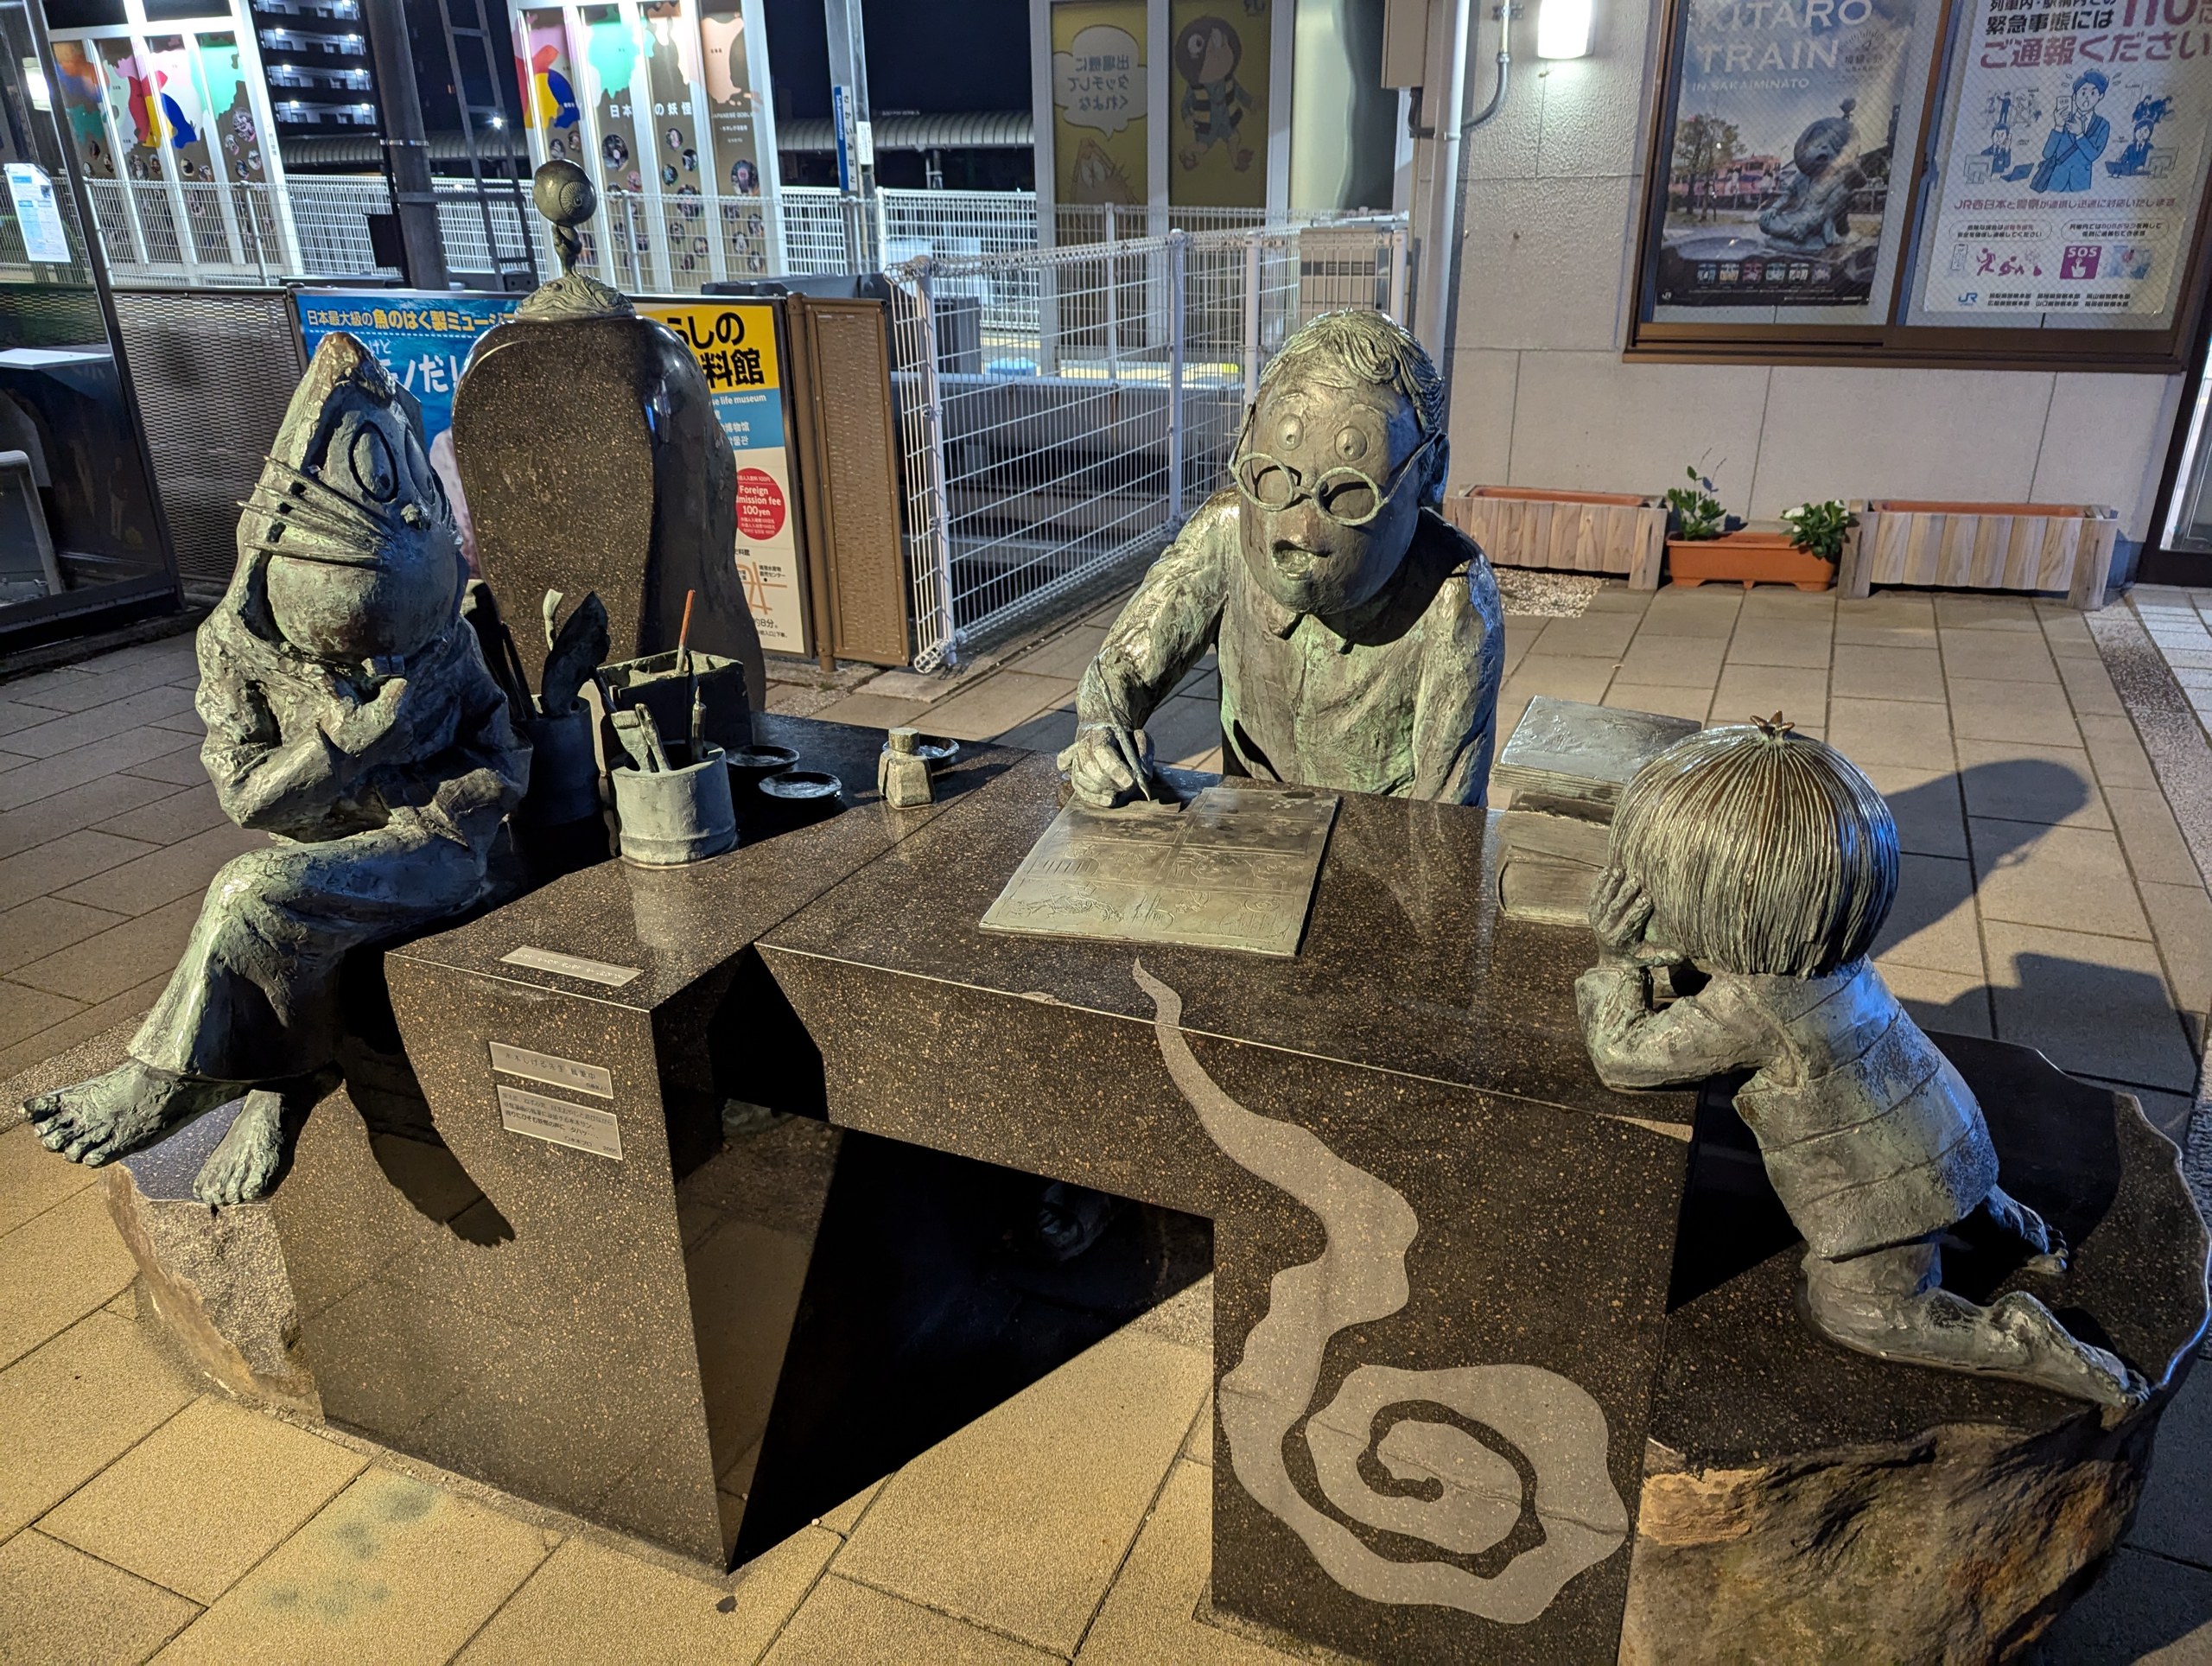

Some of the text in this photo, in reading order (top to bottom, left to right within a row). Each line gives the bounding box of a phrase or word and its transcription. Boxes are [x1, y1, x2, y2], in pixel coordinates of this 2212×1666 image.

[1699, 0, 1872, 33] KITARO
[1986, 10, 2114, 35] 緊急事態には
[1980, 30, 2212, 69] ご通報ください
[1697, 40, 1840, 74] TRAIN
[1692, 78, 1810, 92] IN SAKAIMINATO
[843, 95, 856, 184] さかいみなと
[2067, 247, 2099, 258] SOS
[1958, 292, 1978, 302] JR
[720, 396, 734, 405] life
[734, 394, 767, 404] museum
[739, 486, 769, 498] Foreign
[768, 497, 782, 506] fee
